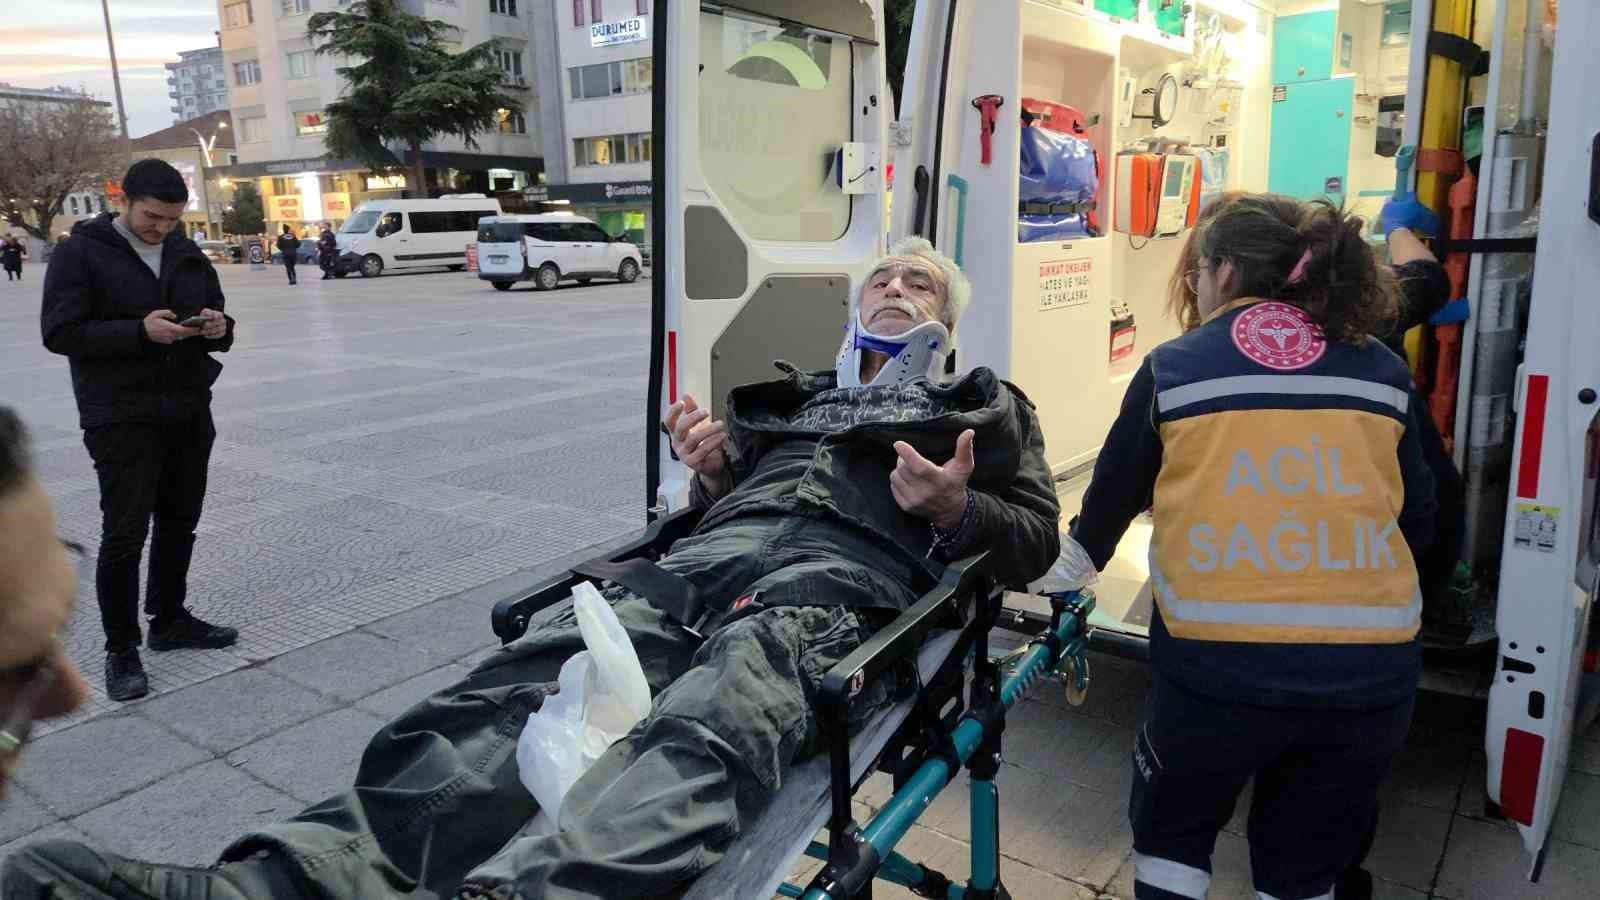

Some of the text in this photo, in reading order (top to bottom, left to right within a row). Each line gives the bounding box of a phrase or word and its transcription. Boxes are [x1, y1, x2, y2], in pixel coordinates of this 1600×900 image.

[592, 20, 640, 37] DURUMED
[1224, 434, 1364, 496] ACİL
[1188, 507, 1399, 574] SAĞLIK
